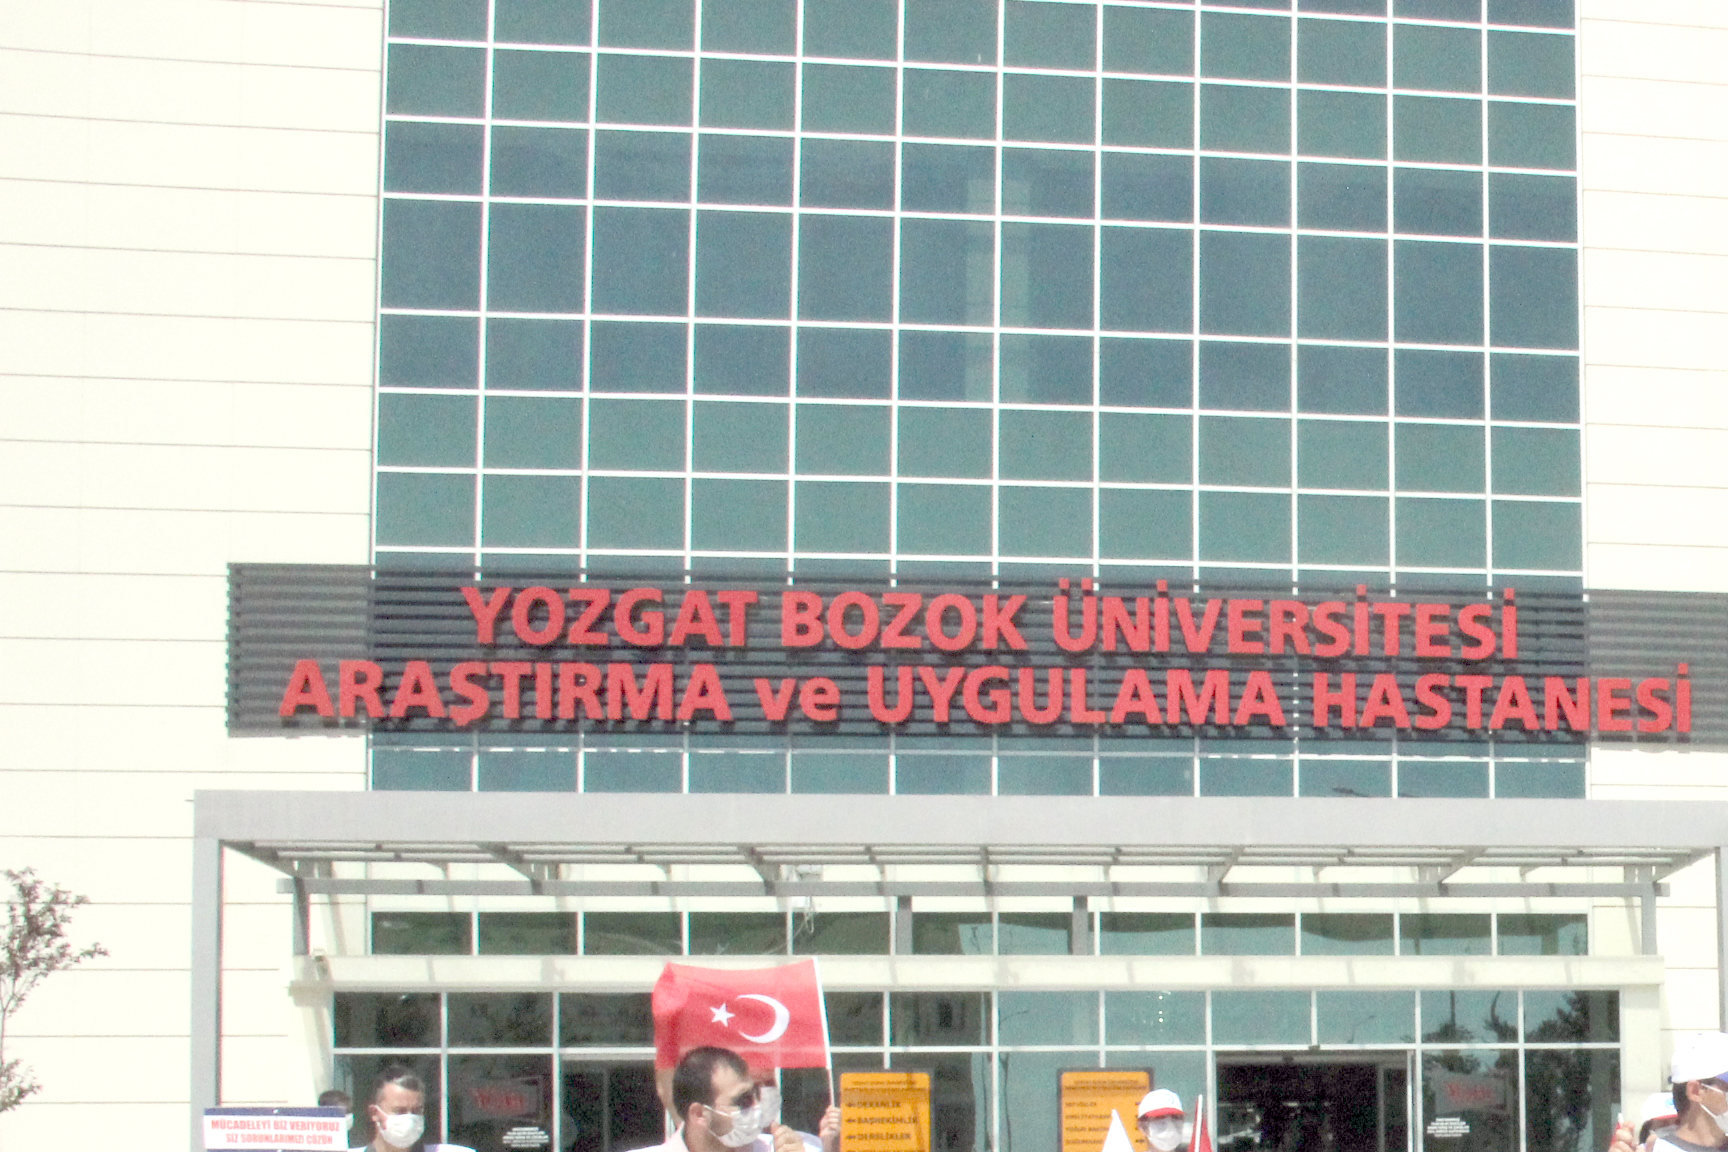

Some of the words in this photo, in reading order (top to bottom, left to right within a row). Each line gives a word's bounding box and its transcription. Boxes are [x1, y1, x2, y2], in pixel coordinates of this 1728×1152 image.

[461, 586, 758, 648] YOZGAT
[781, 591, 1027, 652] BOZOK
[1052, 577, 1518, 659] ÜNİVERSİTESİ
[279, 659, 732, 727] ARAŞTIRMA
[754, 677, 839, 722] ve
[866, 665, 1286, 727] UYGULAMA
[1312, 662, 1692, 733] HASTANESİ
